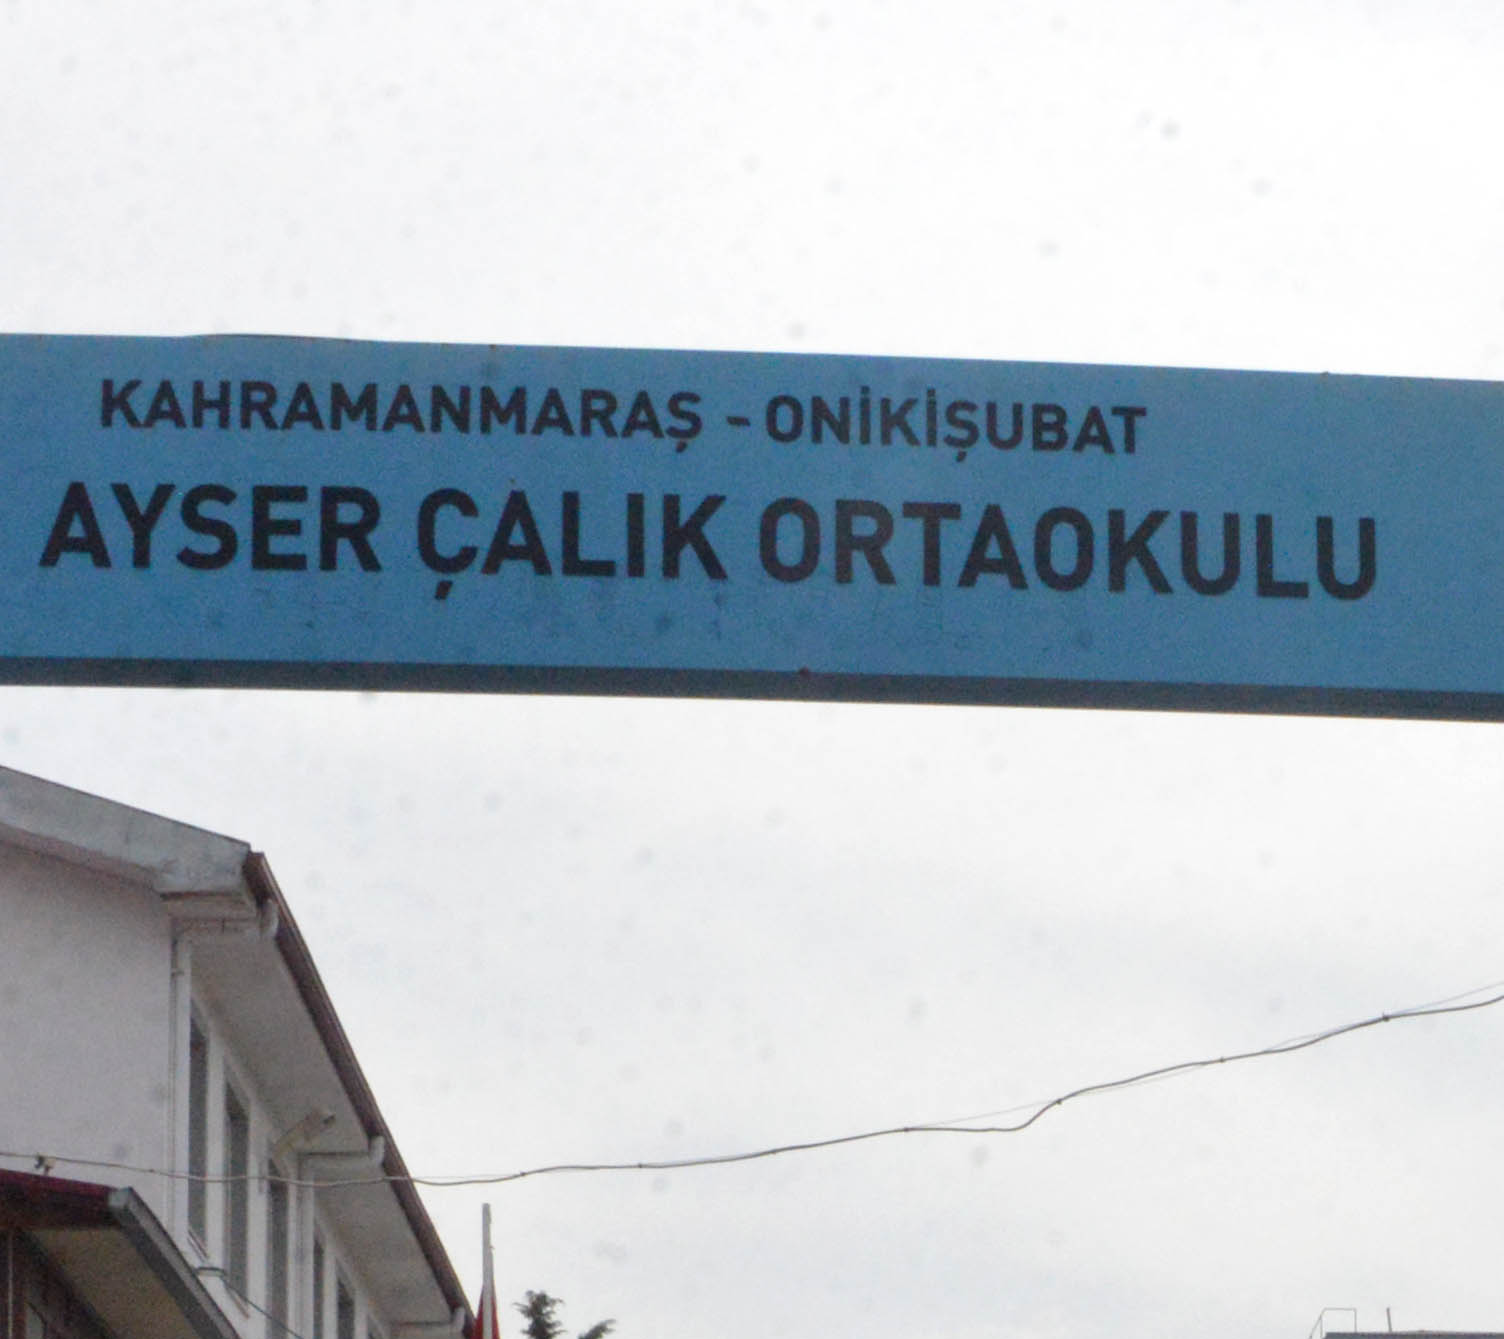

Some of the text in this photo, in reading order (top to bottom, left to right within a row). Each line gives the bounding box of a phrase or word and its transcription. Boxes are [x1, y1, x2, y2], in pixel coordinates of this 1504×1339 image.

[100, 379, 702, 453] KAHRAMANMARAŞ
[765, 386, 1147, 462] ONİKİŞUBAT
[38, 481, 1377, 601] AYSER ÇALIK ORTAOKULU
